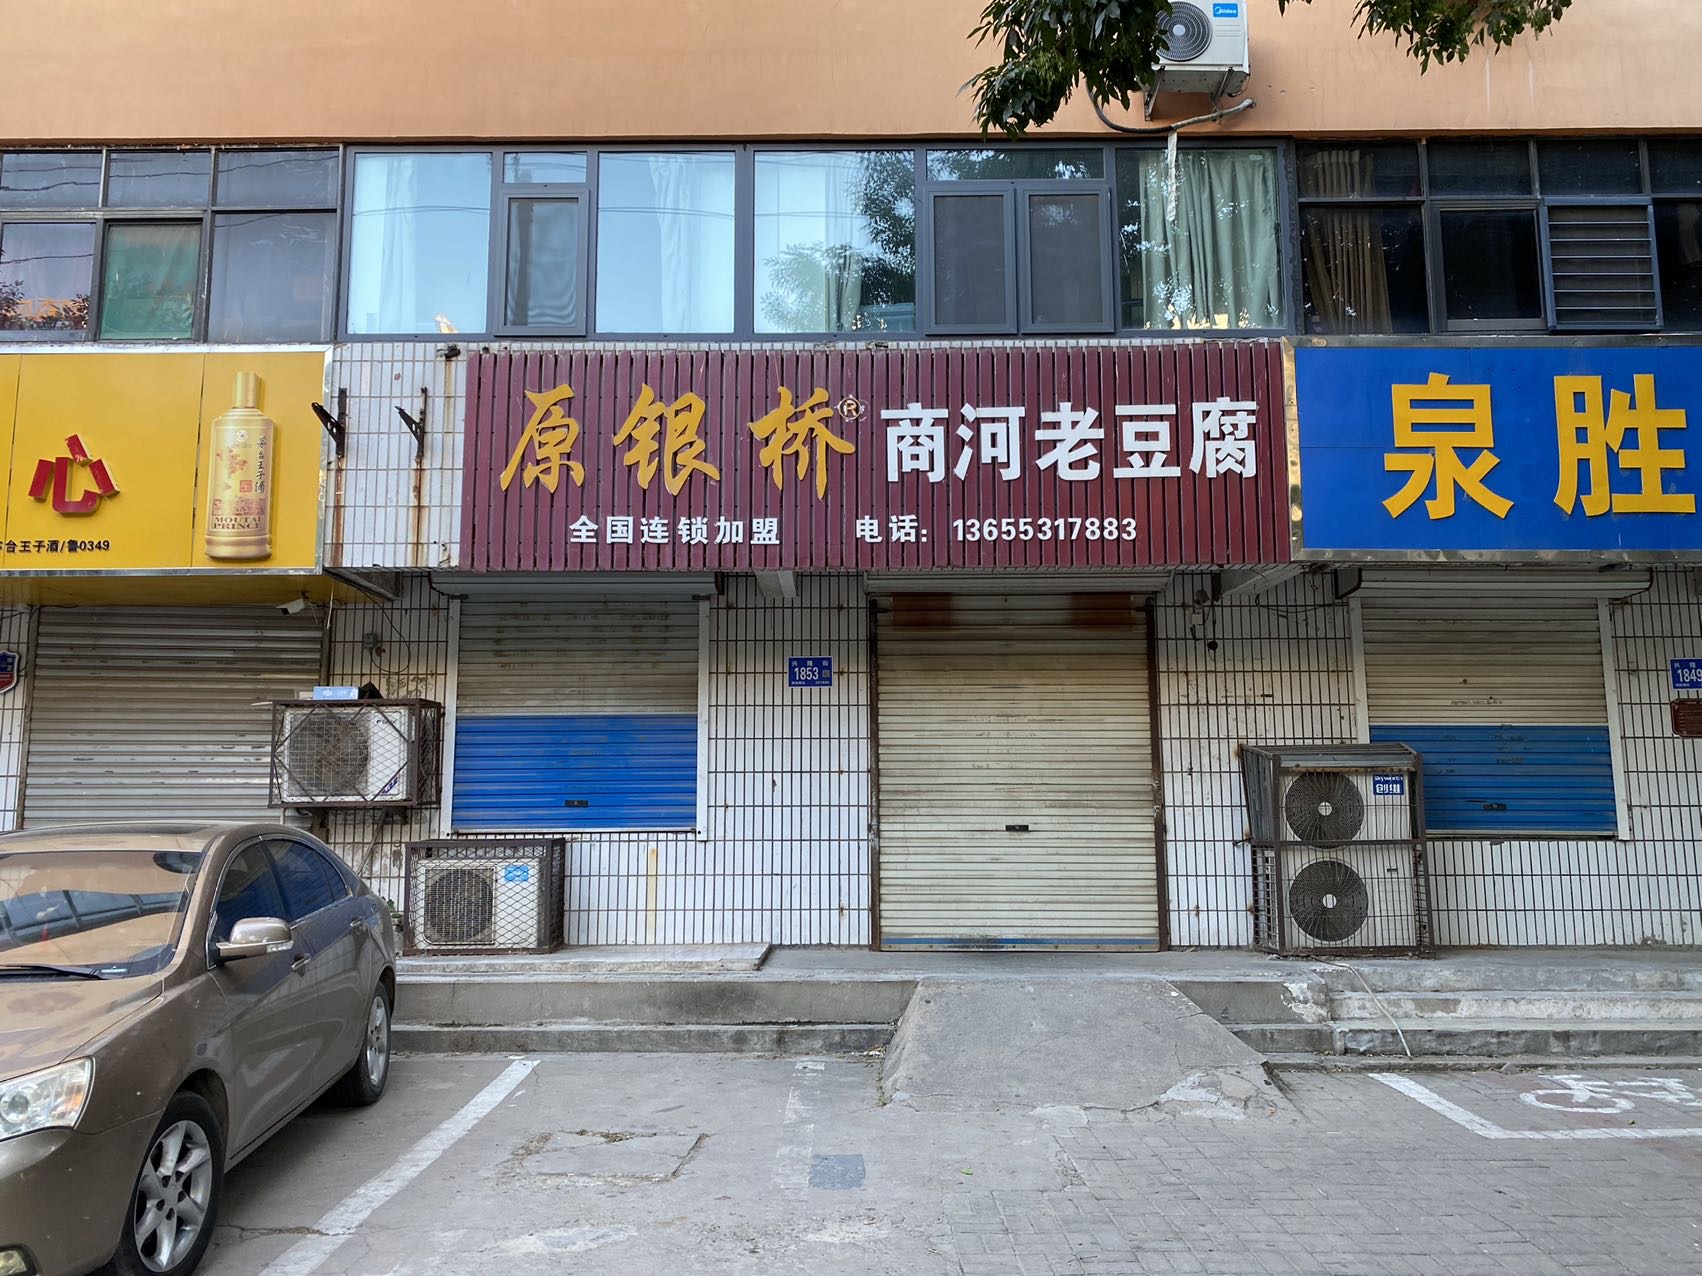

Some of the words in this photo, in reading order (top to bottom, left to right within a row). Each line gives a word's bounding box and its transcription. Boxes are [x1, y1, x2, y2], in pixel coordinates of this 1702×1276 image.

[499, 382, 856, 500] 原银桥
[880, 396, 1258, 483] 商河老豆腐
[1381, 371, 1697, 521] 泉胜
[28, 432, 120, 518] 心
[213, 522, 262, 530] PRINCE
[569, 514, 781, 545] 全国连锁加盟
[953, 517, 1137, 542] 13655317883
[0, 539, 110, 553] 台王子酒/鲁0349
[794, 667, 819, 681] 1853
[1677, 669, 1702, 682] 1849
